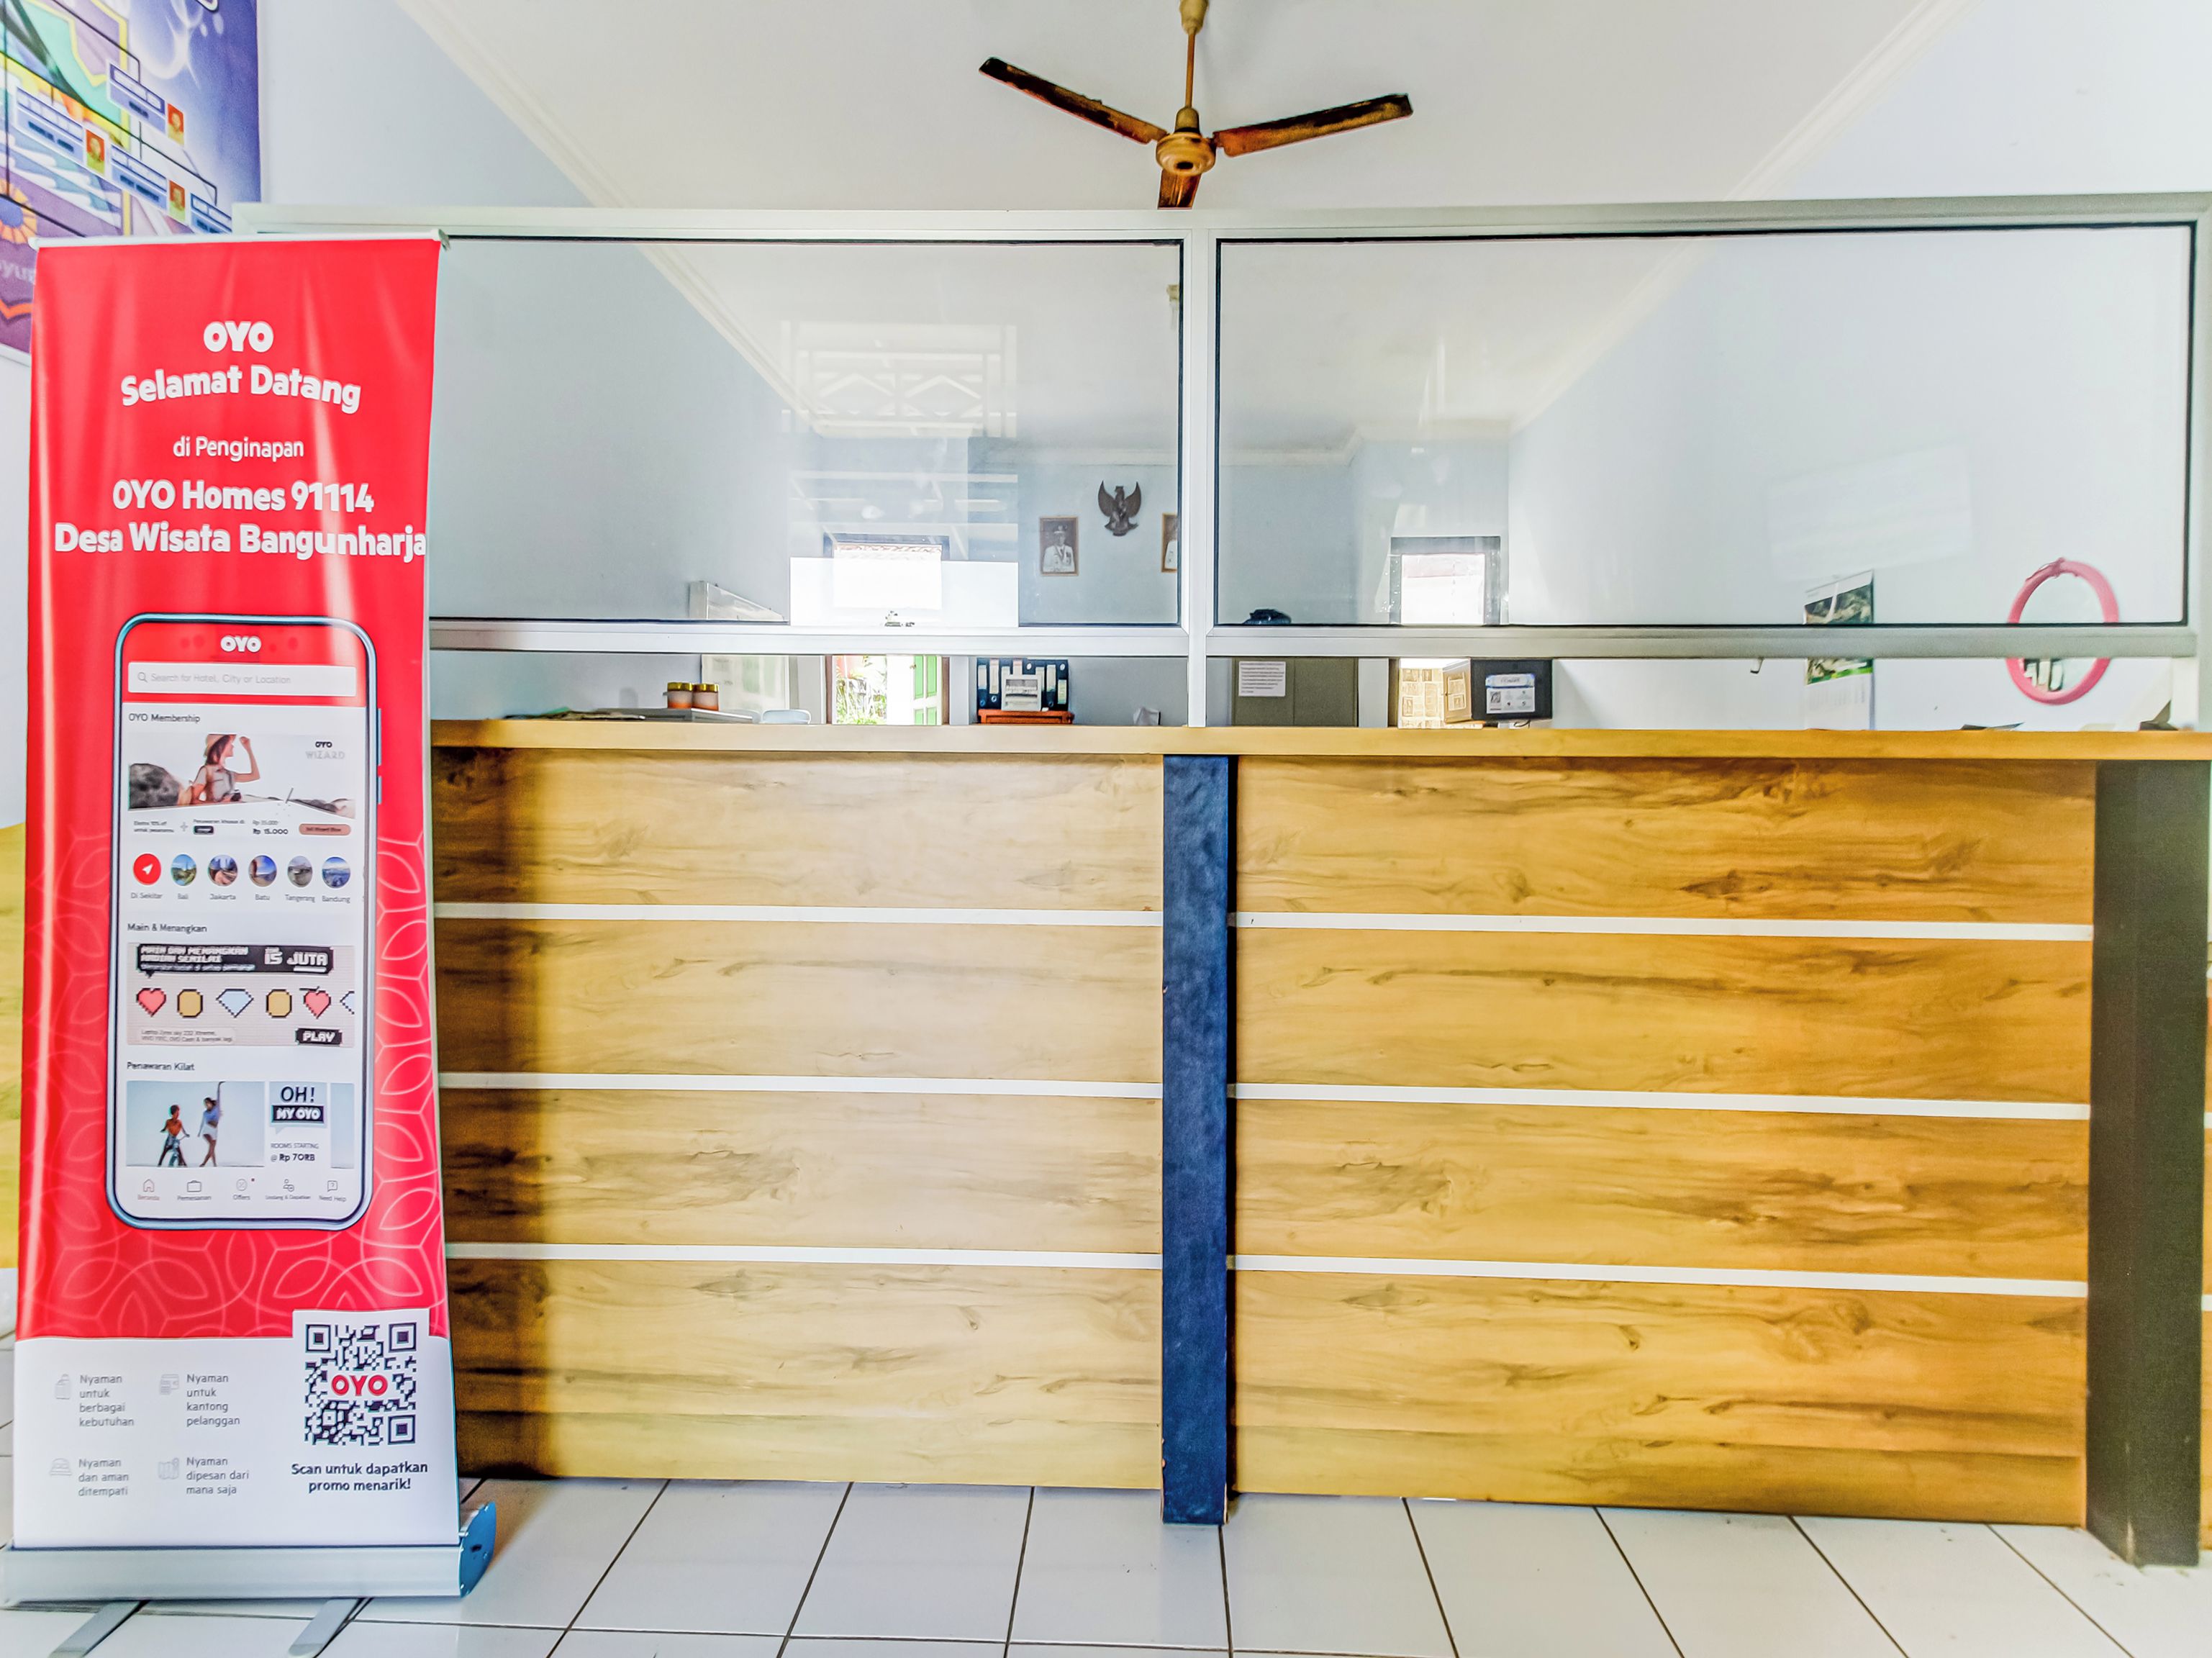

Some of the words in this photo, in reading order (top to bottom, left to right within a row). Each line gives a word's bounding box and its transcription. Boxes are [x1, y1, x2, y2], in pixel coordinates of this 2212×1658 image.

[204, 321, 274, 352] OYO
[121, 366, 242, 407] Selamat
[251, 366, 361, 414] Datang
[173, 437, 190, 458] di
[196, 436, 304, 462] Penginapan
[183, 481, 286, 512] Homes
[291, 481, 374, 513] 91114
[55, 523, 123, 553] Desa
[129, 521, 230, 553] Wisata
[240, 525, 426, 563] Bangunharja
[220, 635, 262, 653] OYO
[150, 673, 178, 683] Search
[181, 673, 191, 683] for
[222, 674, 241, 685] City
[255, 675, 291, 685] Location
[128, 713, 148, 722] OYO
[151, 713, 201, 723] Membership
[305, 751, 345, 760] WIZARD
[322, 895, 350, 904] Bandung
[127, 923, 149, 932] Main
[151, 923, 158, 932] &
[160, 924, 207, 933] Menangkan
[286, 951, 328, 966] JUTA
[303, 1031, 335, 1043] PLAY
[127, 1061, 172, 1071] Penawaran
[174, 1062, 195, 1072] Kilat
[281, 1086, 315, 1103] OH!
[276, 1107, 293, 1120] MY
[295, 1107, 321, 1120] OYO
[278, 1154, 290, 1162] Rp
[80, 1374, 122, 1385] Nyaman
[186, 1373, 229, 1385] Nyaman
[331, 1374, 389, 1397] OYO
[79, 1388, 110, 1399] untuk
[186, 1387, 217, 1398] untuk
[79, 1402, 126, 1415] berbagai
[186, 1401, 229, 1414] kantong
[79, 1417, 135, 1427] kebutuhan
[186, 1415, 240, 1428] pelanggan
[78, 1458, 122, 1469] Nyaman
[186, 1457, 228, 1469] Nyaman
[291, 1463, 322, 1476] Scan
[325, 1463, 362, 1474] untuk
[366, 1462, 428, 1477] dapatkan
[78, 1472, 97, 1482] dan
[101, 1474, 130, 1482] aman
[186, 1470, 227, 1483] dipesan
[230, 1469, 250, 1480] dari
[78, 1485, 128, 1497] ditempati
[186, 1485, 214, 1495] mana
[217, 1485, 237, 1497] saja
[308, 1480, 350, 1493] promo
[353, 1478, 411, 1491] menarik!
